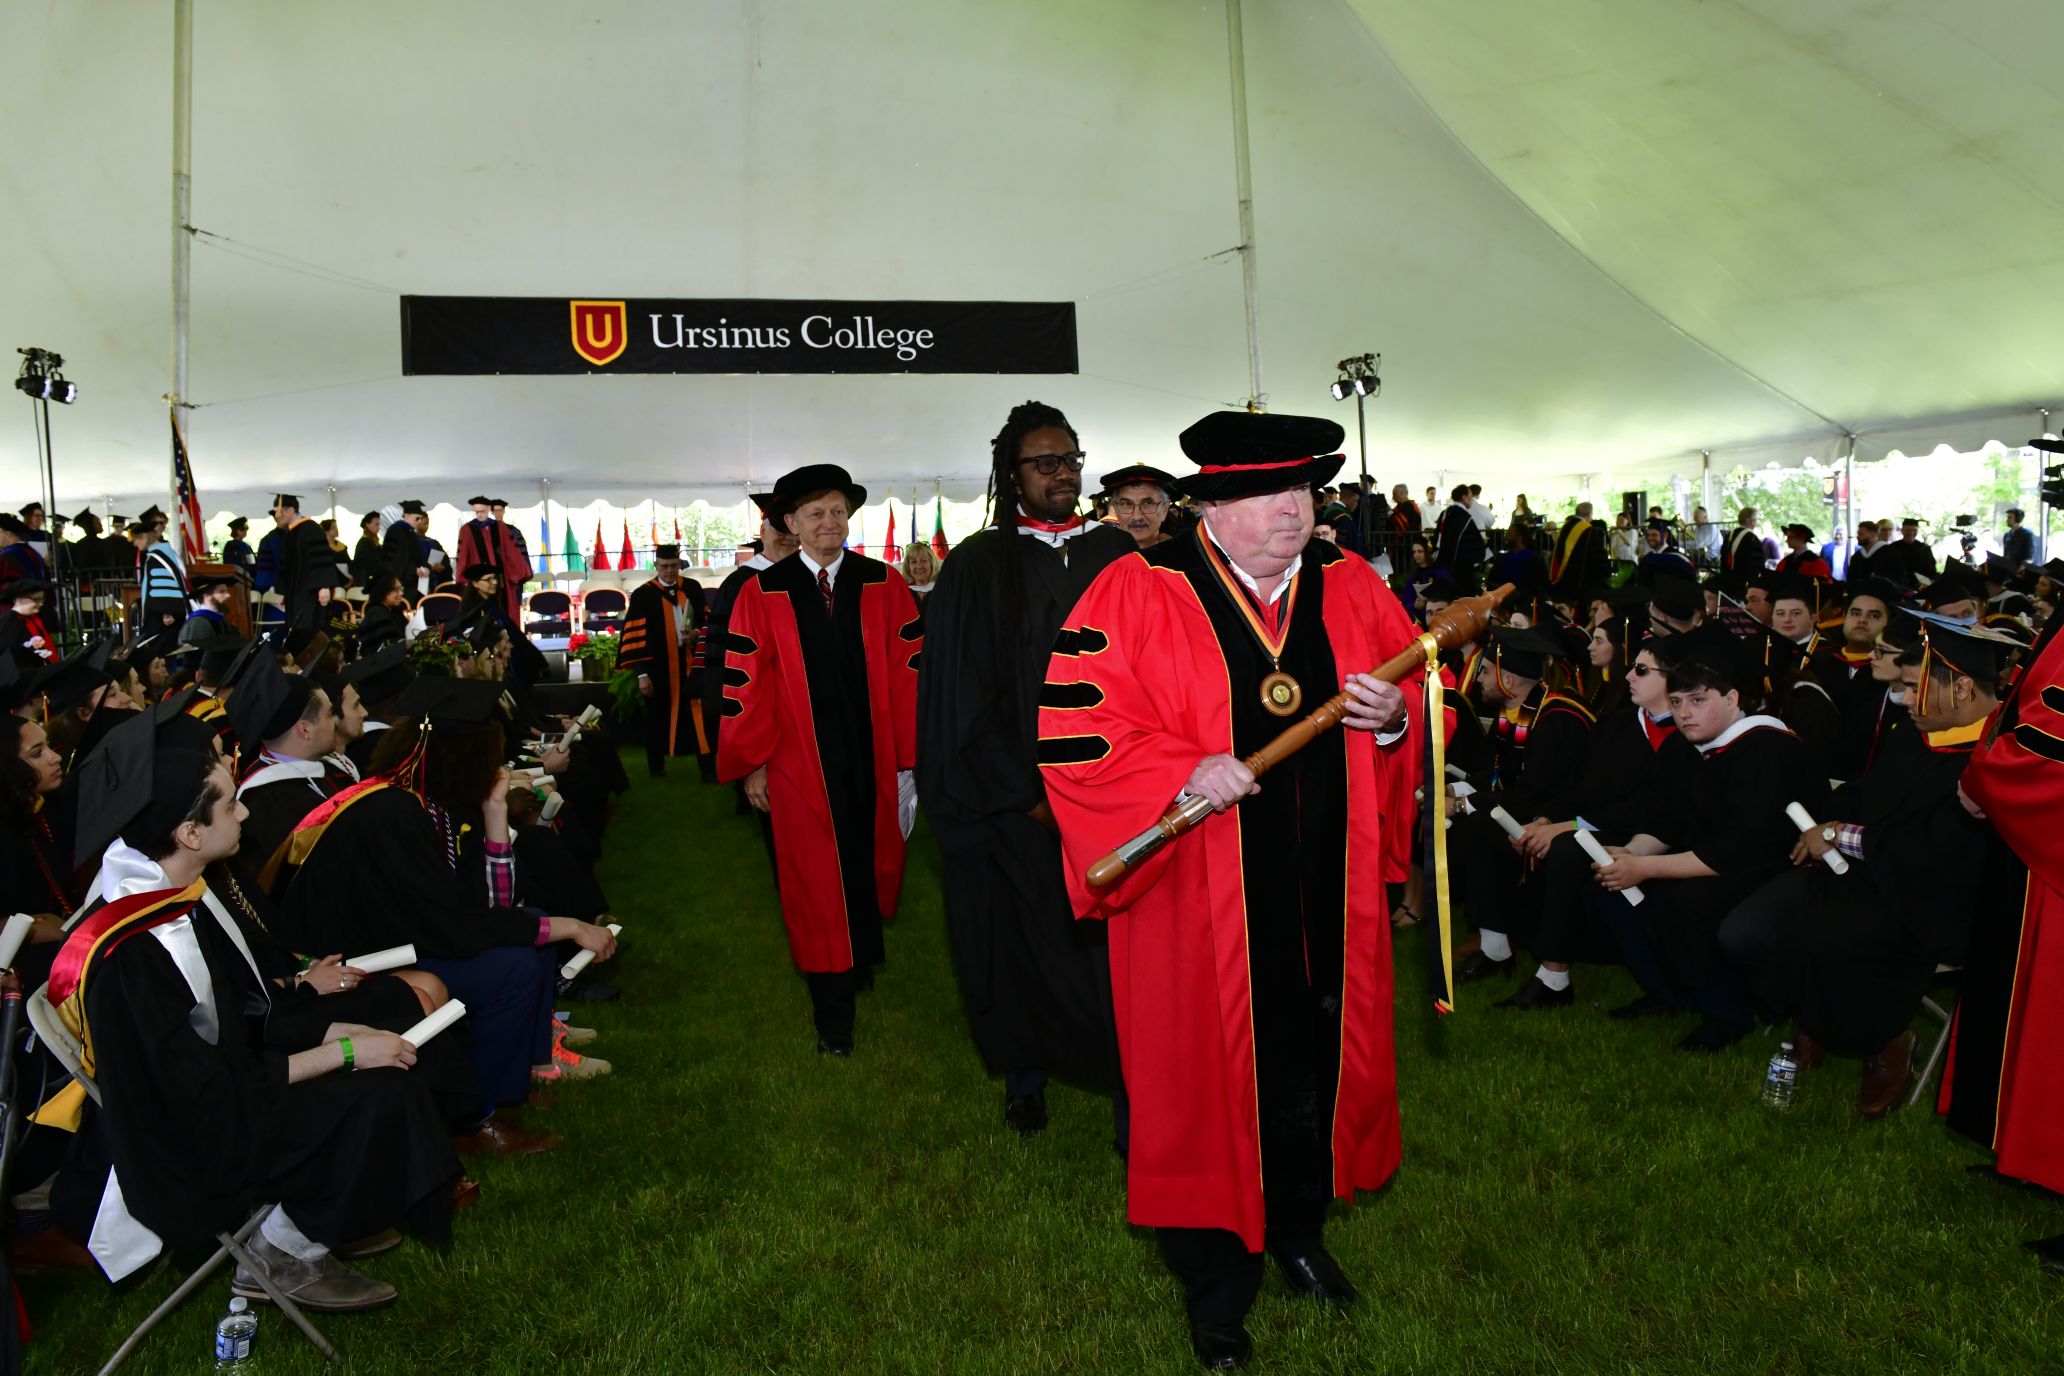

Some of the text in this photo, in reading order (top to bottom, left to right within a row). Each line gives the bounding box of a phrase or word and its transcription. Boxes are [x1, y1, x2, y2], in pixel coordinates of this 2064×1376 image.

[585, 313, 612, 348] U
[648, 313, 935, 361] Ursinus College
